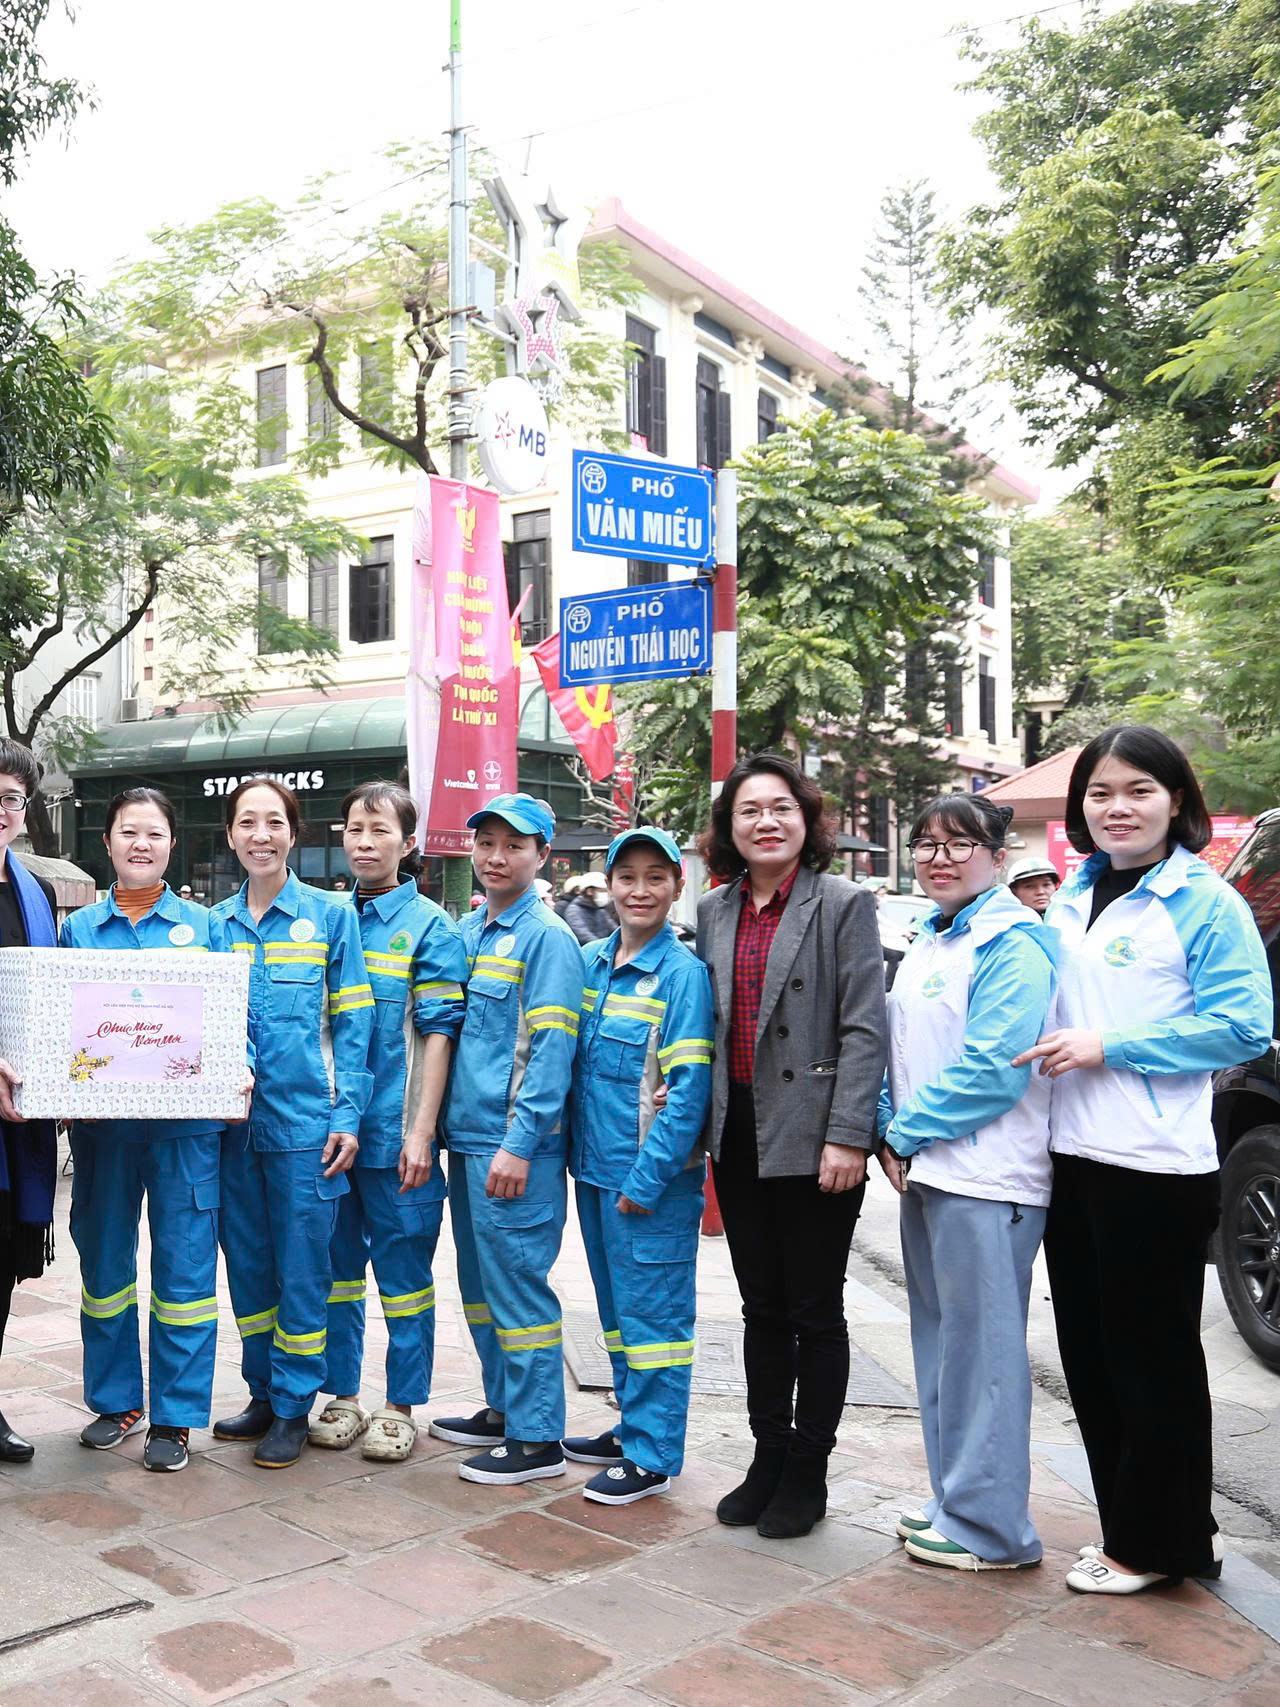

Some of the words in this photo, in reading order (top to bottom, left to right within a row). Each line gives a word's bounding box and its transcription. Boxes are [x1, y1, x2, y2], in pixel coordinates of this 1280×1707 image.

[519, 424, 546, 457] MB
[631, 475, 677, 499] PHỐ
[586, 497, 636, 541] VĂN
[642, 506, 702, 550] MIẾU
[617, 592, 666, 621] PHỐ
[570, 625, 626, 671] NGUYỄN
[631, 625, 665, 664] THÁI
[669, 627, 700, 667] HỌC
[203, 770, 324, 797] STAUCKS
